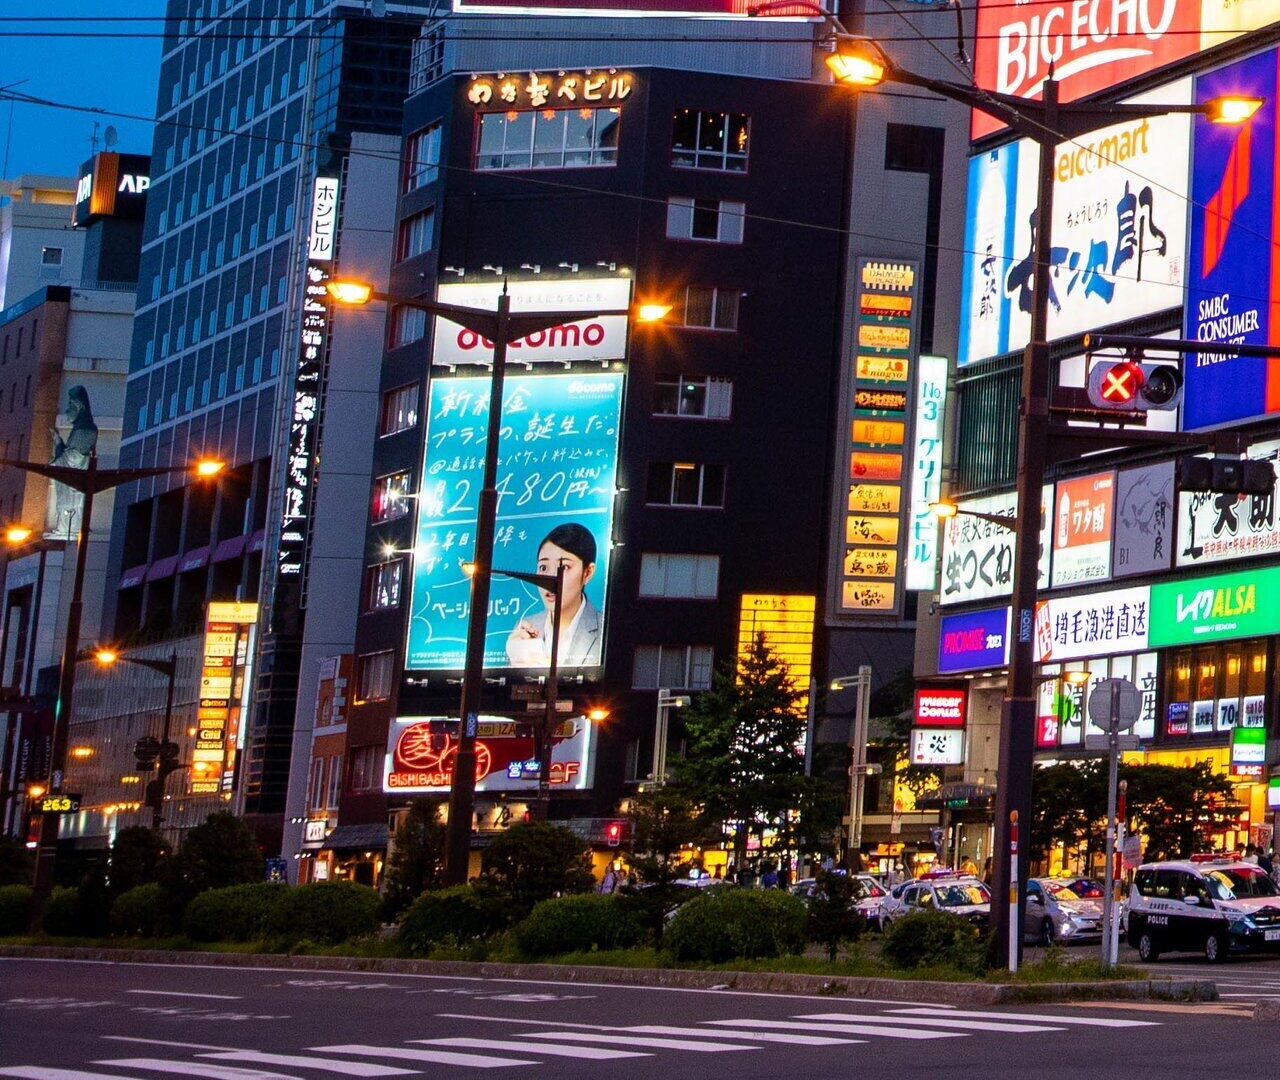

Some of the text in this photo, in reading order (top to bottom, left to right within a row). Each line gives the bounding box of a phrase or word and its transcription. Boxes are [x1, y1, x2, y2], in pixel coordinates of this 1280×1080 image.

[312, 185, 335, 252] ホシビル
[1066, 199, 1109, 227] ちょうじろう
[1199, 294, 1230, 321] SMBC
[1197, 309, 1259, 344] CONSUMER
[922, 382, 943, 399] No.
[924, 400, 938, 420] 3
[944, 543, 1012, 596] 生つくね
[1054, 601, 1147, 646] 増毛漁港直送
[943, 627, 985, 654] PROMISE
[1147, 915, 1169, 925] POLICE
